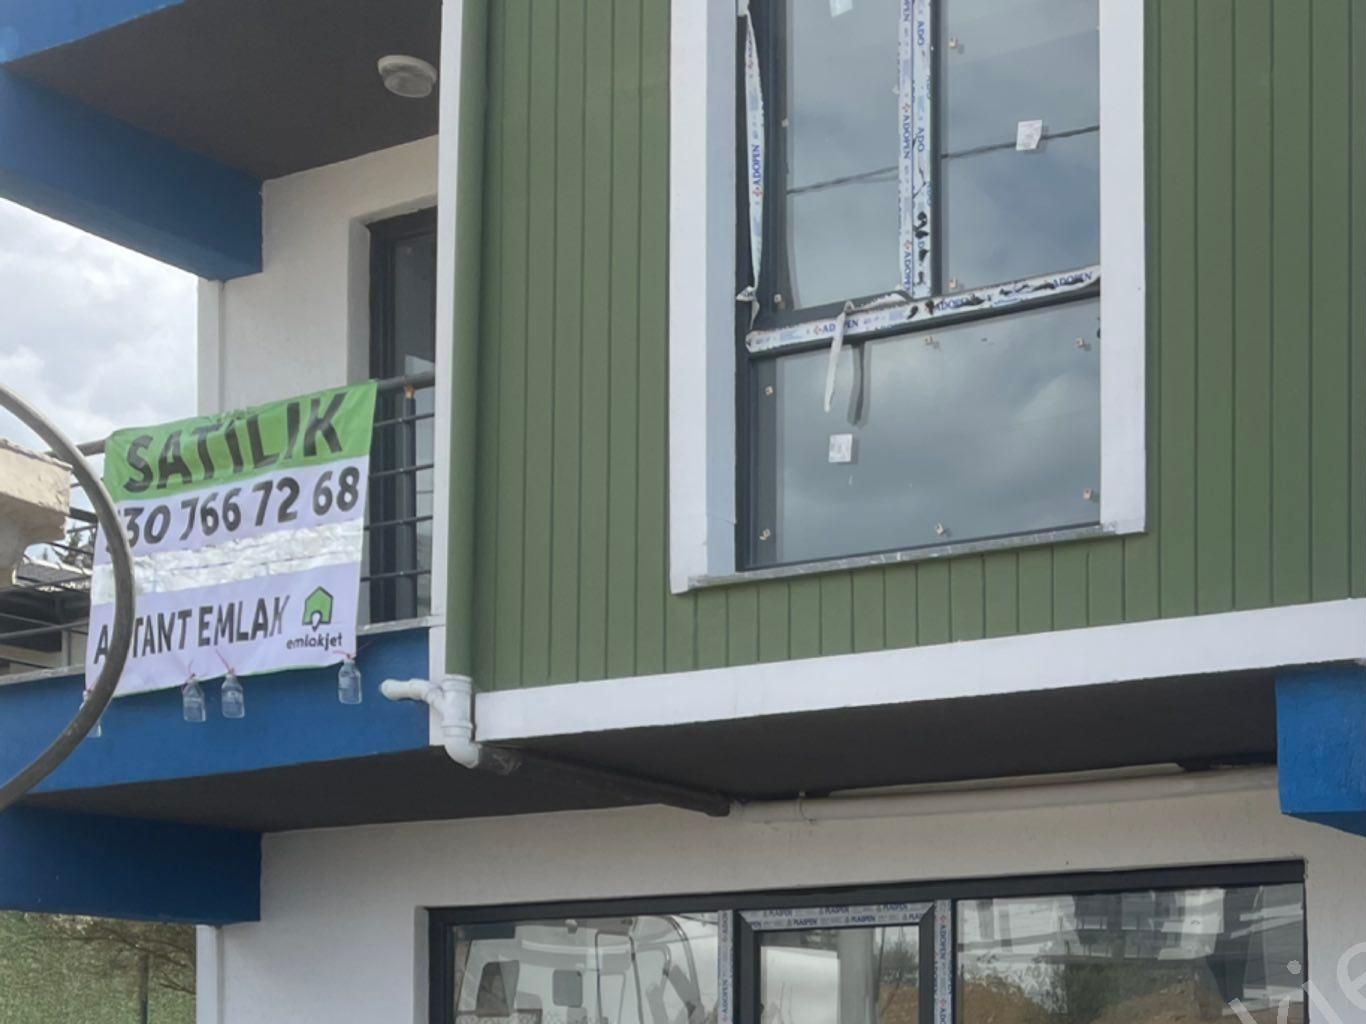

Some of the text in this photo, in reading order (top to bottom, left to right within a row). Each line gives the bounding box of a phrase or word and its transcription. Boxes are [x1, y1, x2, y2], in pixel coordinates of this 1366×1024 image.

[751, 144, 761, 186] ADOPEN
[823, 319, 859, 333] ADPEN
[123, 392, 348, 492] SATILIK
[106, 466, 360, 550] 30 766 72 68
[94, 595, 290, 665] ATANT EMLAK
[286, 632, 342, 651] emlakjet
